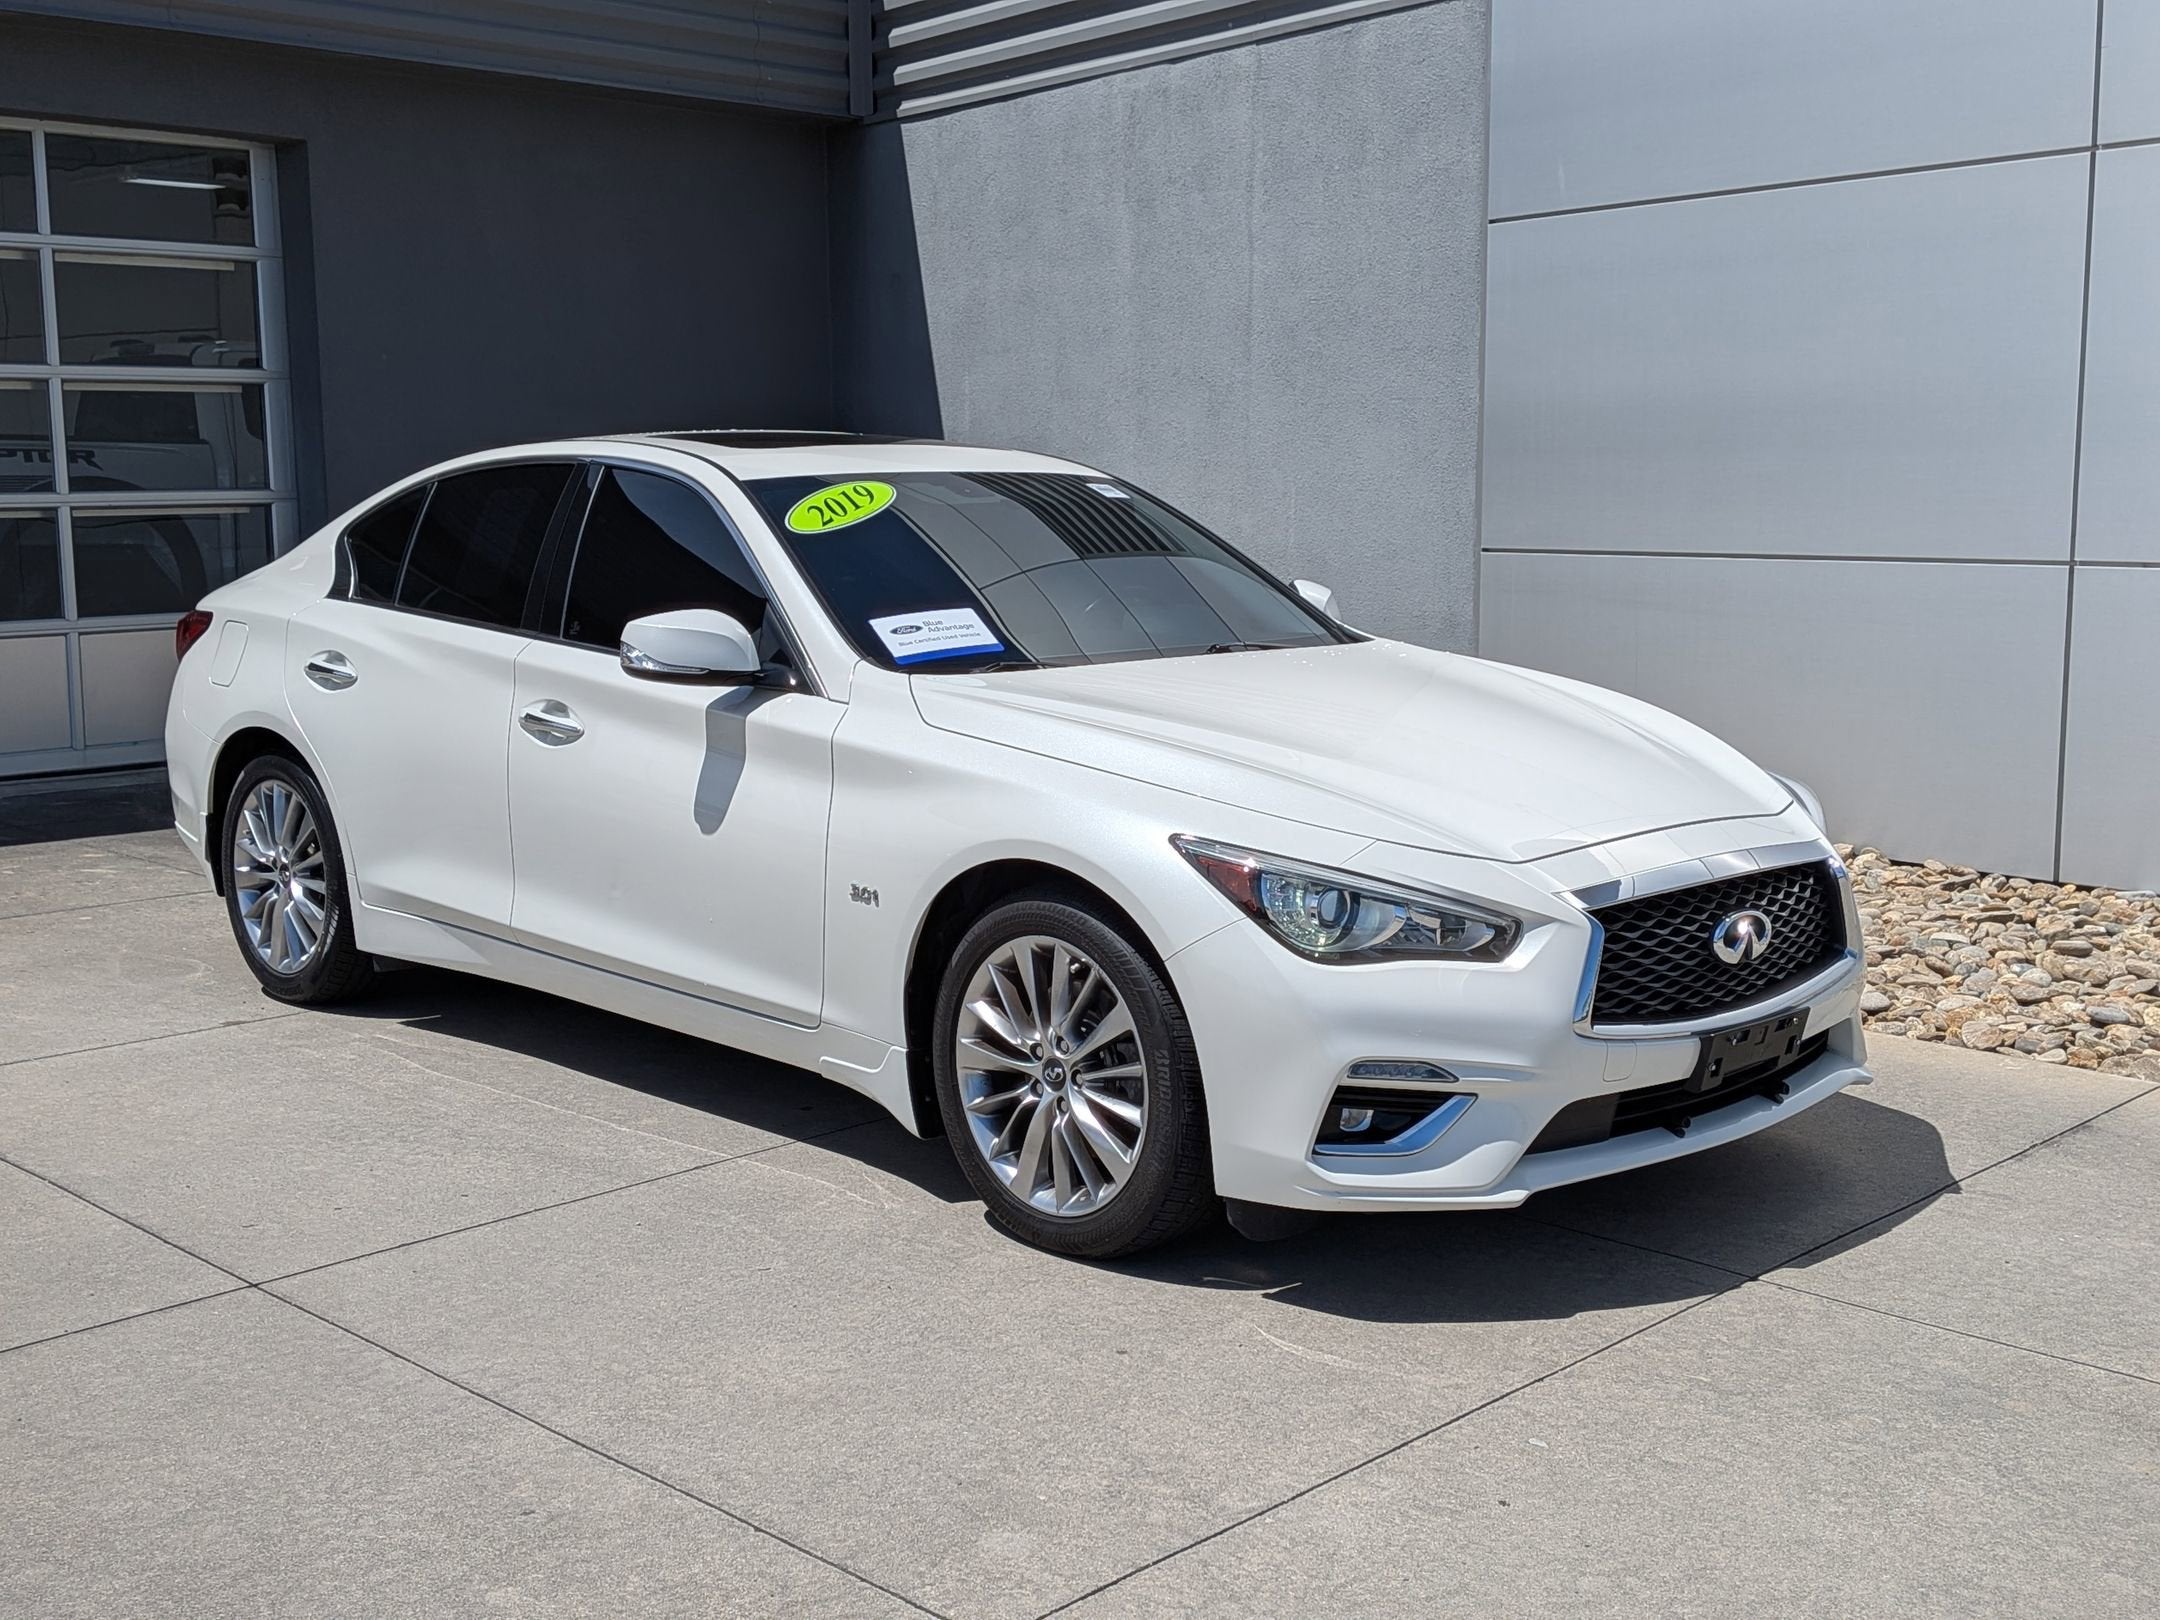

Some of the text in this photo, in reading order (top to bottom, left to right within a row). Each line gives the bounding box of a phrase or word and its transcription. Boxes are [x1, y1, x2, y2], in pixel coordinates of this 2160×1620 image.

[807, 484, 875, 527] 2019
[922, 619, 944, 627] Blue
[928, 623, 975, 633] Advantage
[914, 636, 941, 645] Certified
[941, 633, 958, 641] Used
[958, 631, 981, 639] Vehicle
